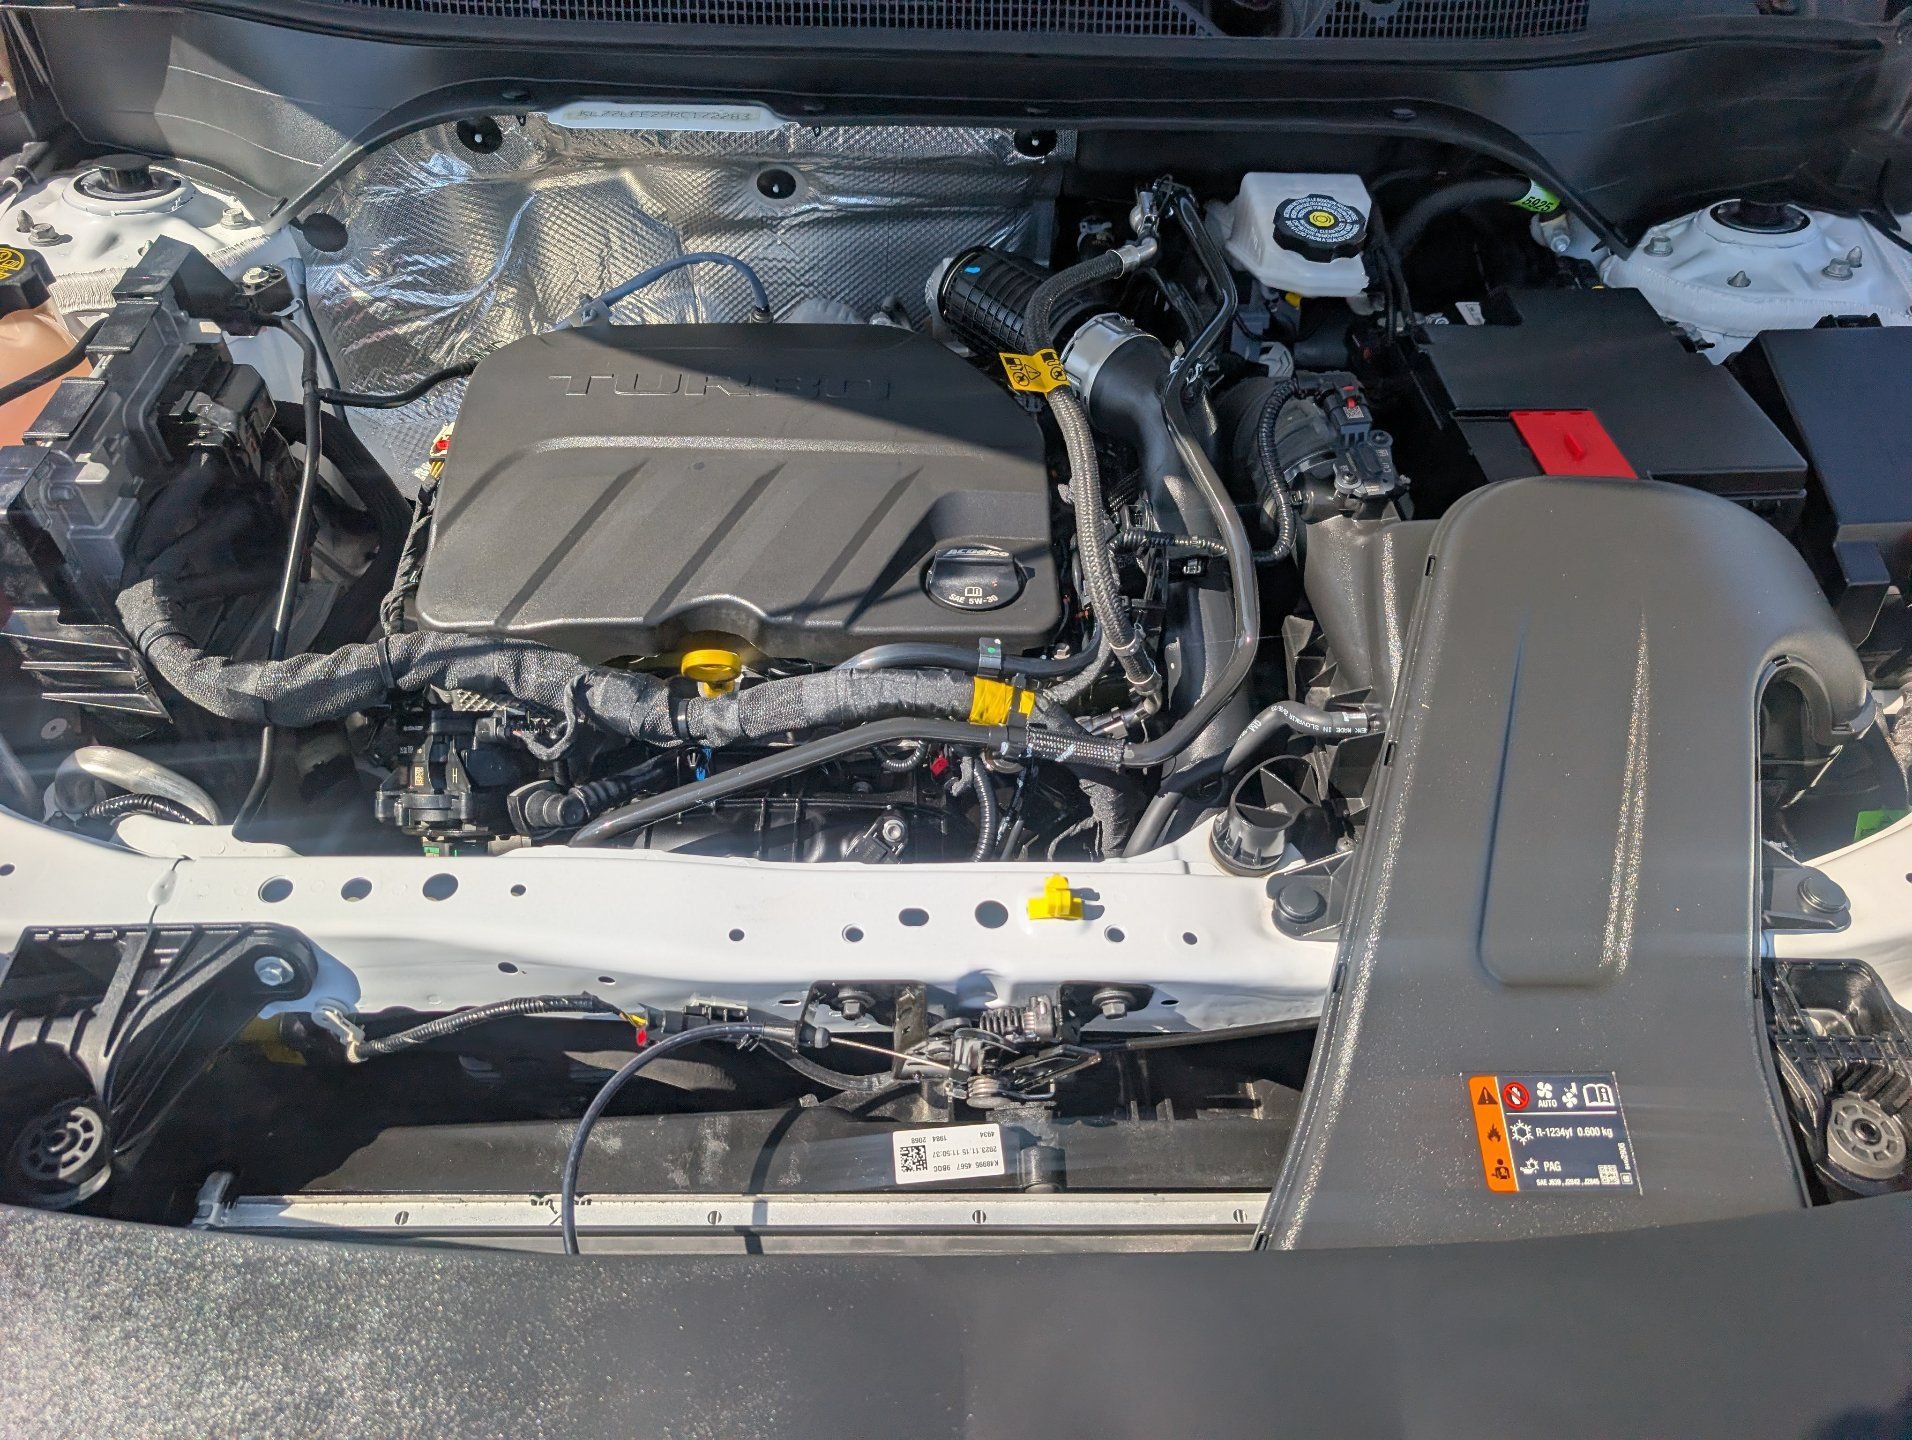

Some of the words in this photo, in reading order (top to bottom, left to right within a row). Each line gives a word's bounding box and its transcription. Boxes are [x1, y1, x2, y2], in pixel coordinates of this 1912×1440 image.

[549, 373, 890, 396] TURBO
[944, 548, 1010, 557] ACDelco
[949, 593, 965, 603] SAE
[969, 594, 998, 604] 5W-30
[1538, 1100, 1558, 1108] AUTO
[1536, 1127, 1573, 1139] R-1234yf
[1577, 1127, 1600, 1136] 0.600
[1602, 1127, 1613, 1138] kg
[1544, 1161, 1562, 1172] PAG
